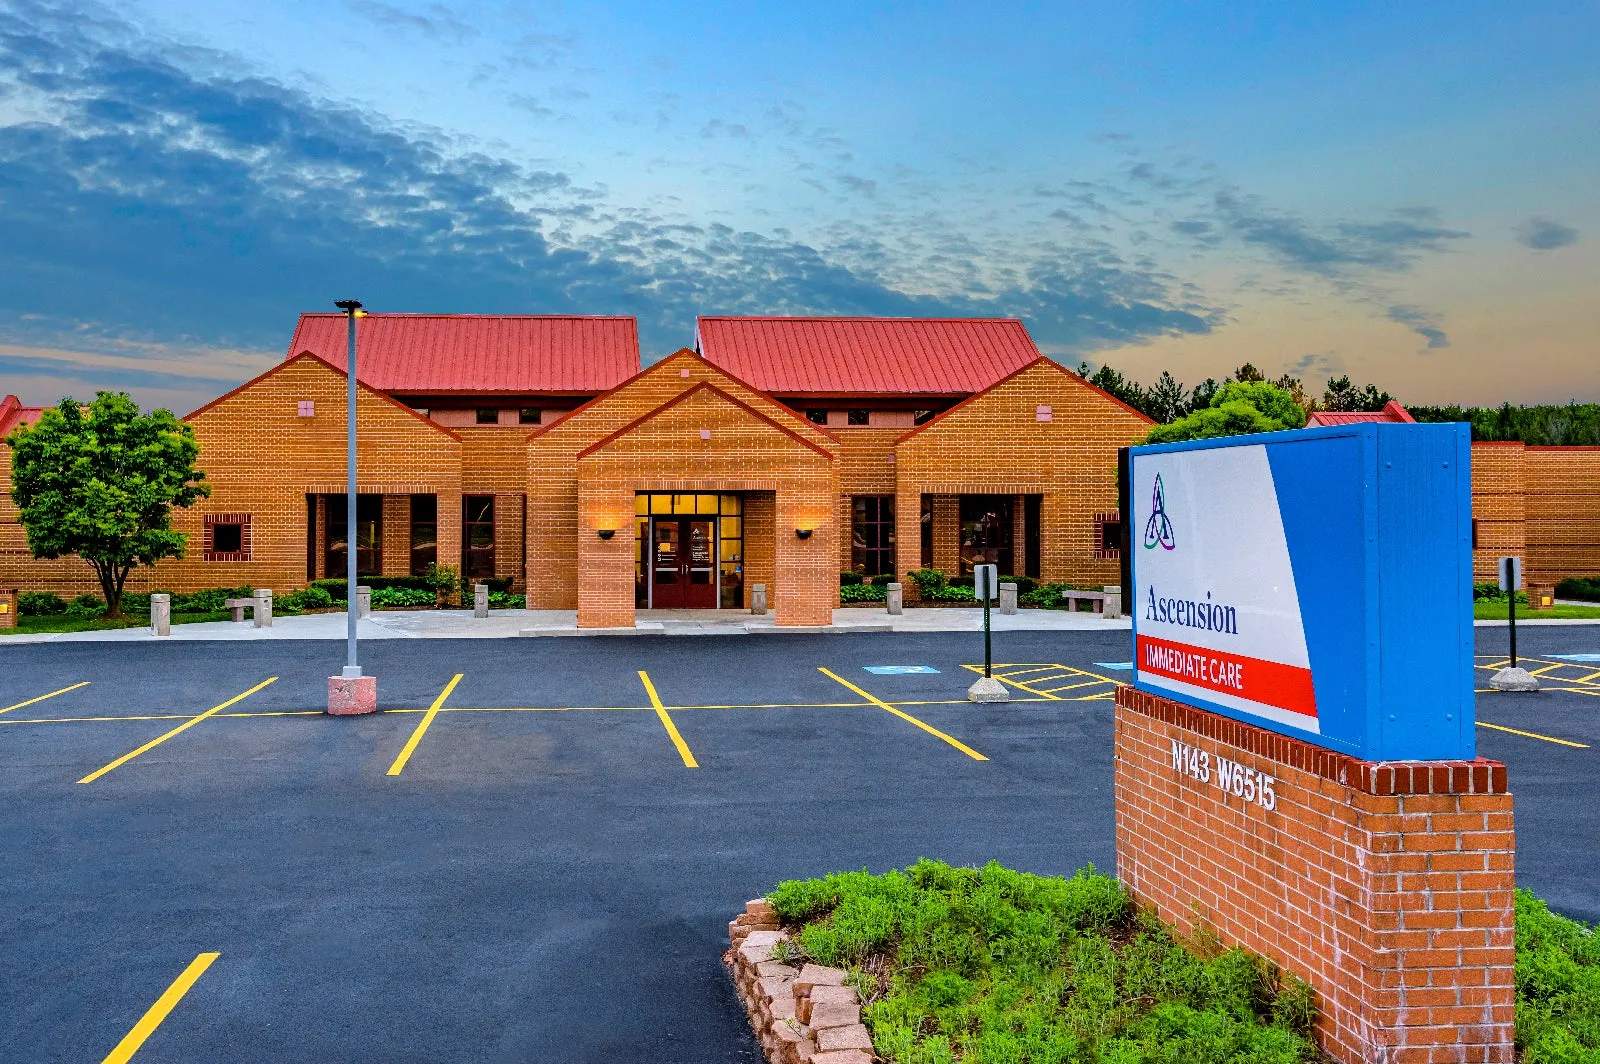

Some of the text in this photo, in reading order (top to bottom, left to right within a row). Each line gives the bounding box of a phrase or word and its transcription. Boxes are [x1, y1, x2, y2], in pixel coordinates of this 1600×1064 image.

[1146, 585, 1238, 634] Ascension
[1146, 644, 1243, 689] IMMEDIATE CARE
[1172, 739, 1276, 811] N143 W6515
